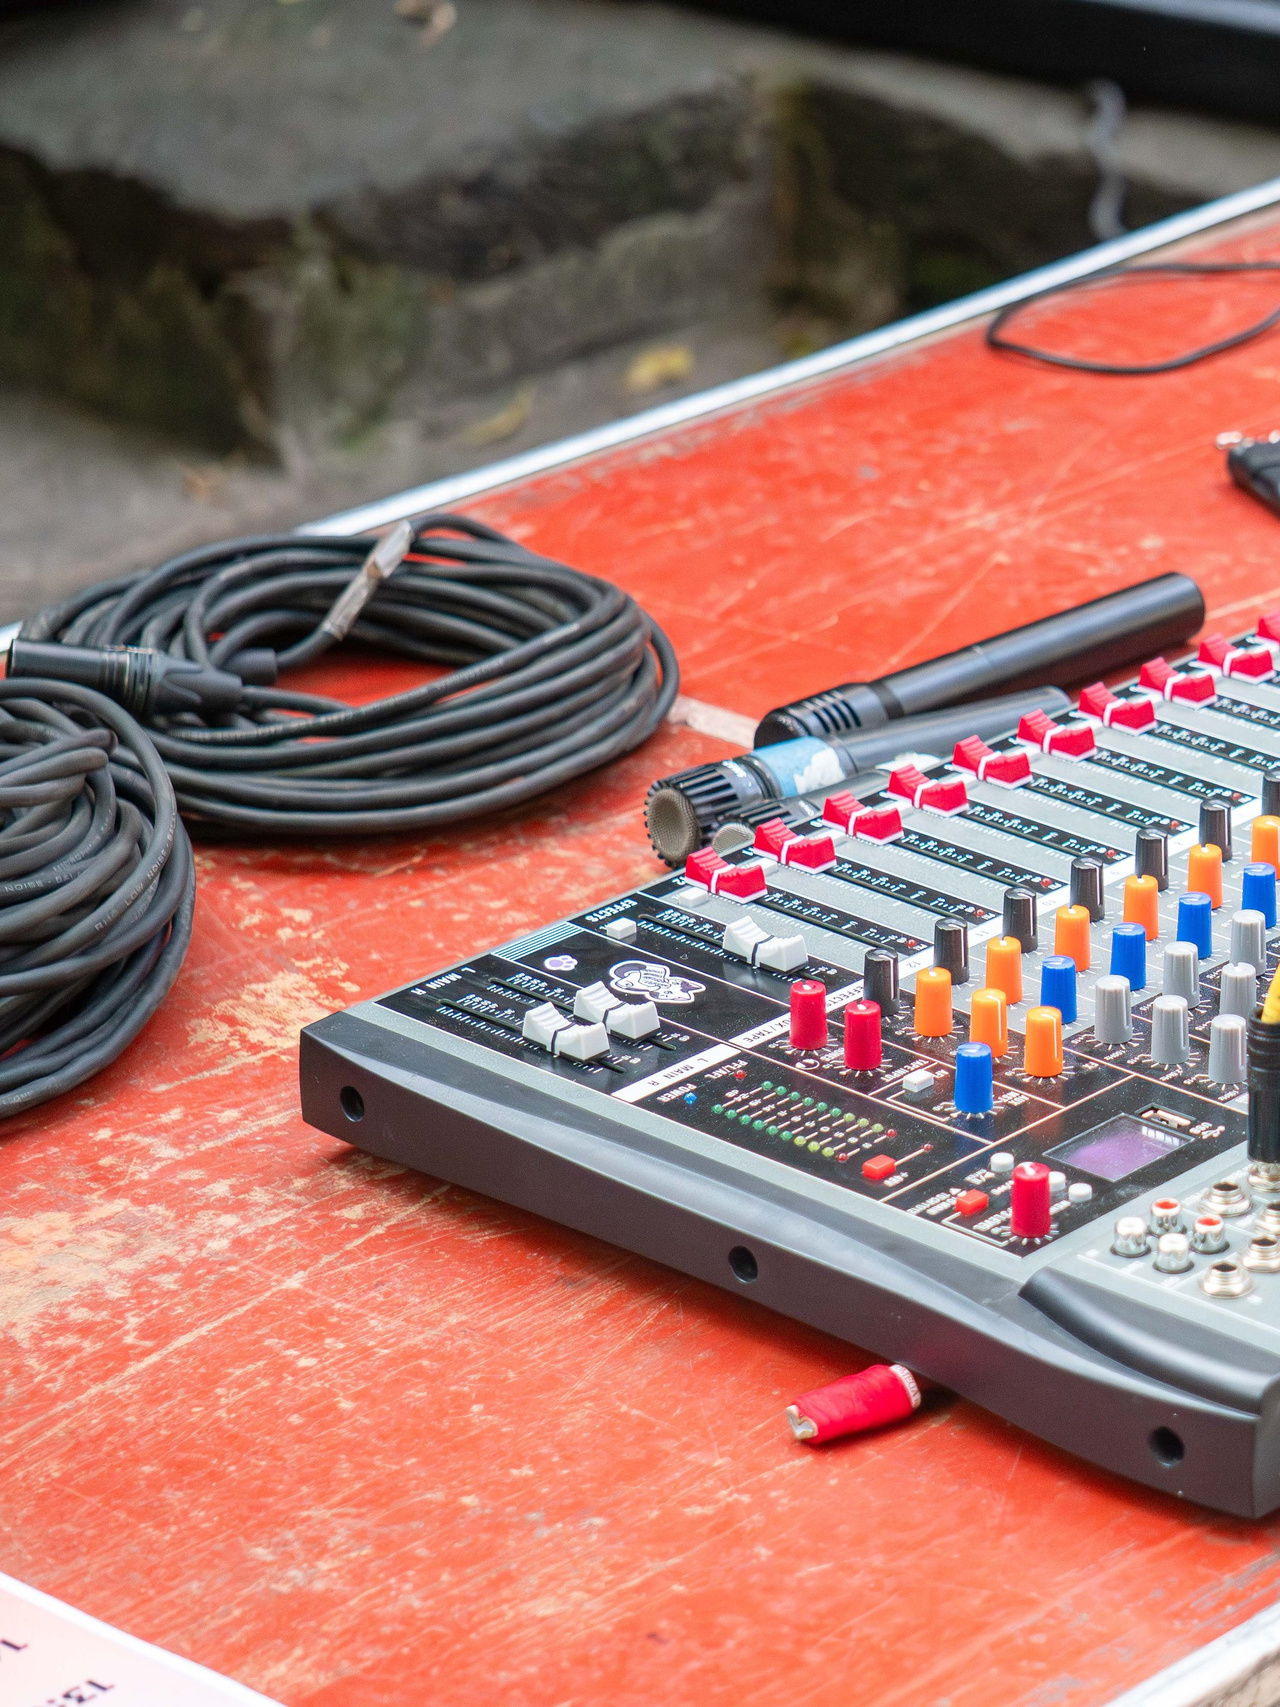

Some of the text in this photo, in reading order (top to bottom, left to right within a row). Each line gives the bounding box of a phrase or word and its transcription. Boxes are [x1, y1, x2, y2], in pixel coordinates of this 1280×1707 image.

[584, 898, 638, 922] EFFECTS
[426, 972, 462, 990] MAIN
[410, 987, 427, 996] R
[743, 1027, 773, 1043] TAPE
[663, 1064, 694, 1080] MAIN
[704, 1059, 748, 1080] PFL/AFL
[881, 1058, 929, 1083] TAPE INPUT
[656, 1082, 698, 1103] POWER
[1007, 1094, 1030, 1107] AUX
[1189, 1121, 1213, 1135] USB
[883, 1172, 909, 1188] +48V
